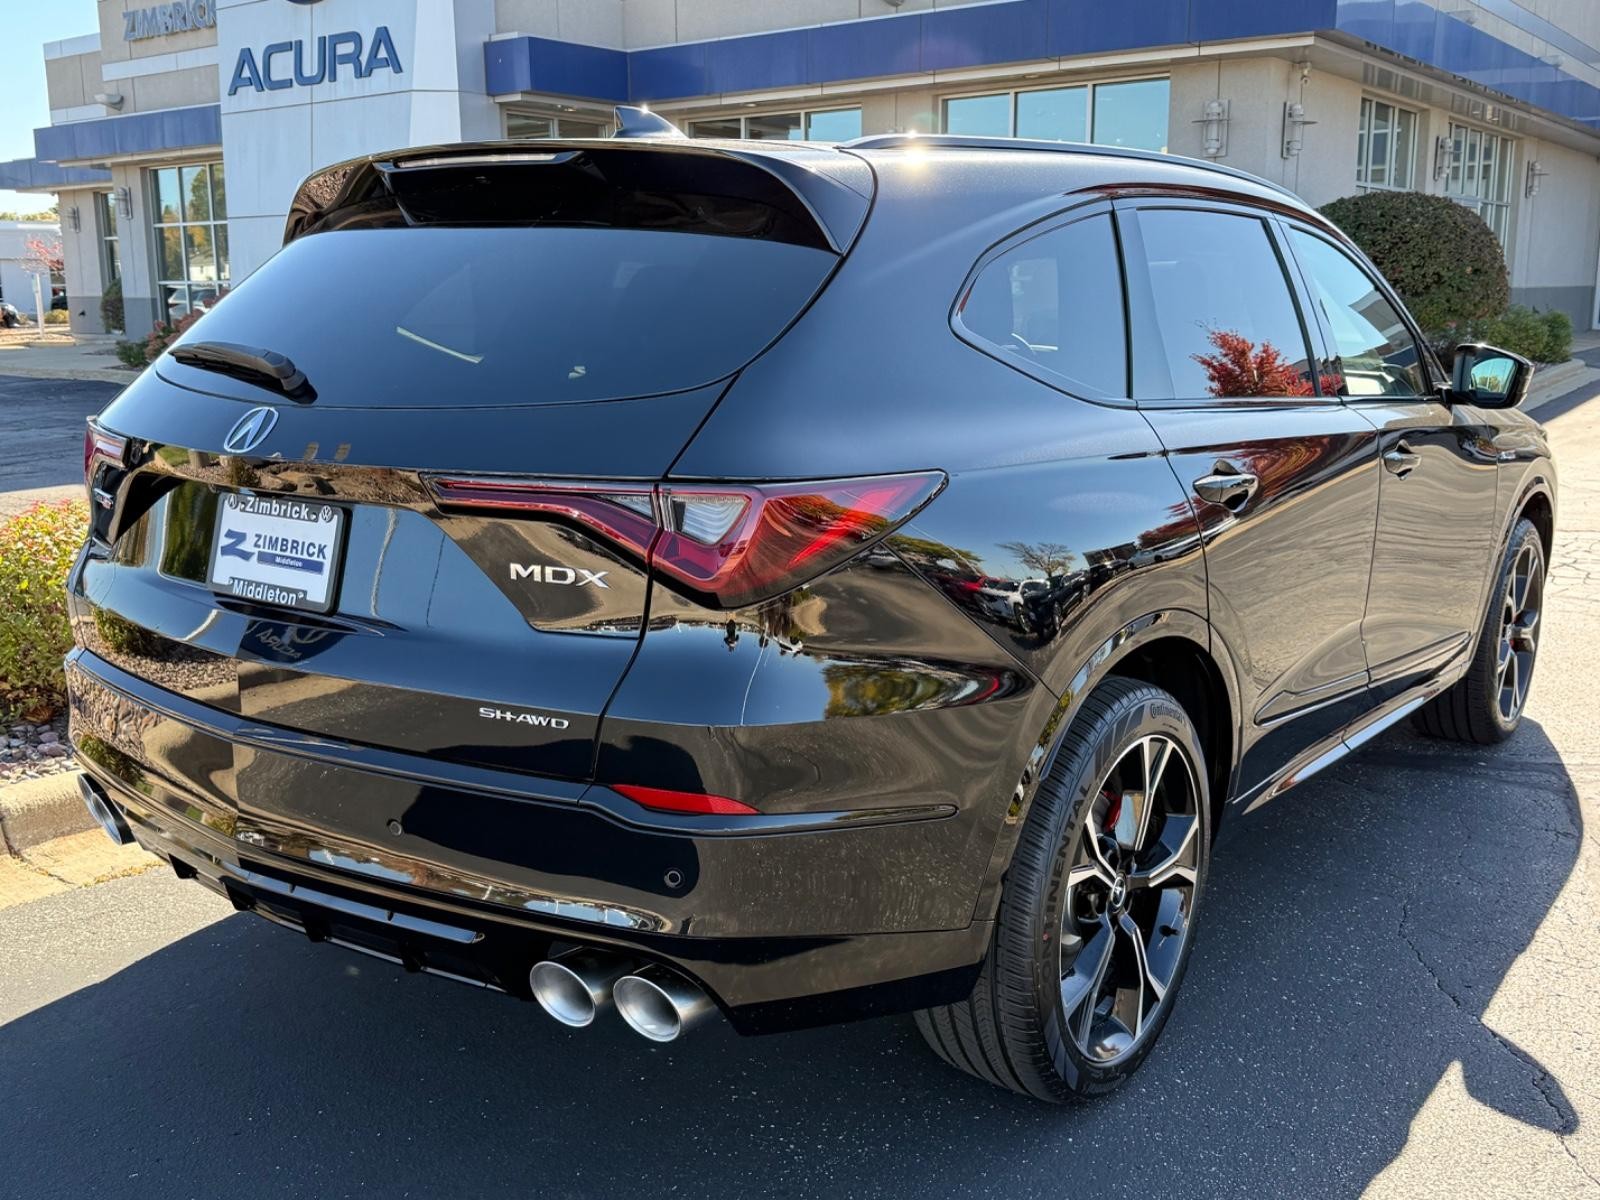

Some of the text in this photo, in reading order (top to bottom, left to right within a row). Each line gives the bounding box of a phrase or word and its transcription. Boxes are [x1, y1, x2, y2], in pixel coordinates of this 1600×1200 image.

[227, 26, 403, 96] ACURA
[245, 496, 310, 520] Zimbrick
[253, 533, 328, 560] ZIMBRICK
[509, 562, 611, 590] MDX
[232, 580, 297, 606] Middleton
[478, 707, 569, 730] SH-AWD
